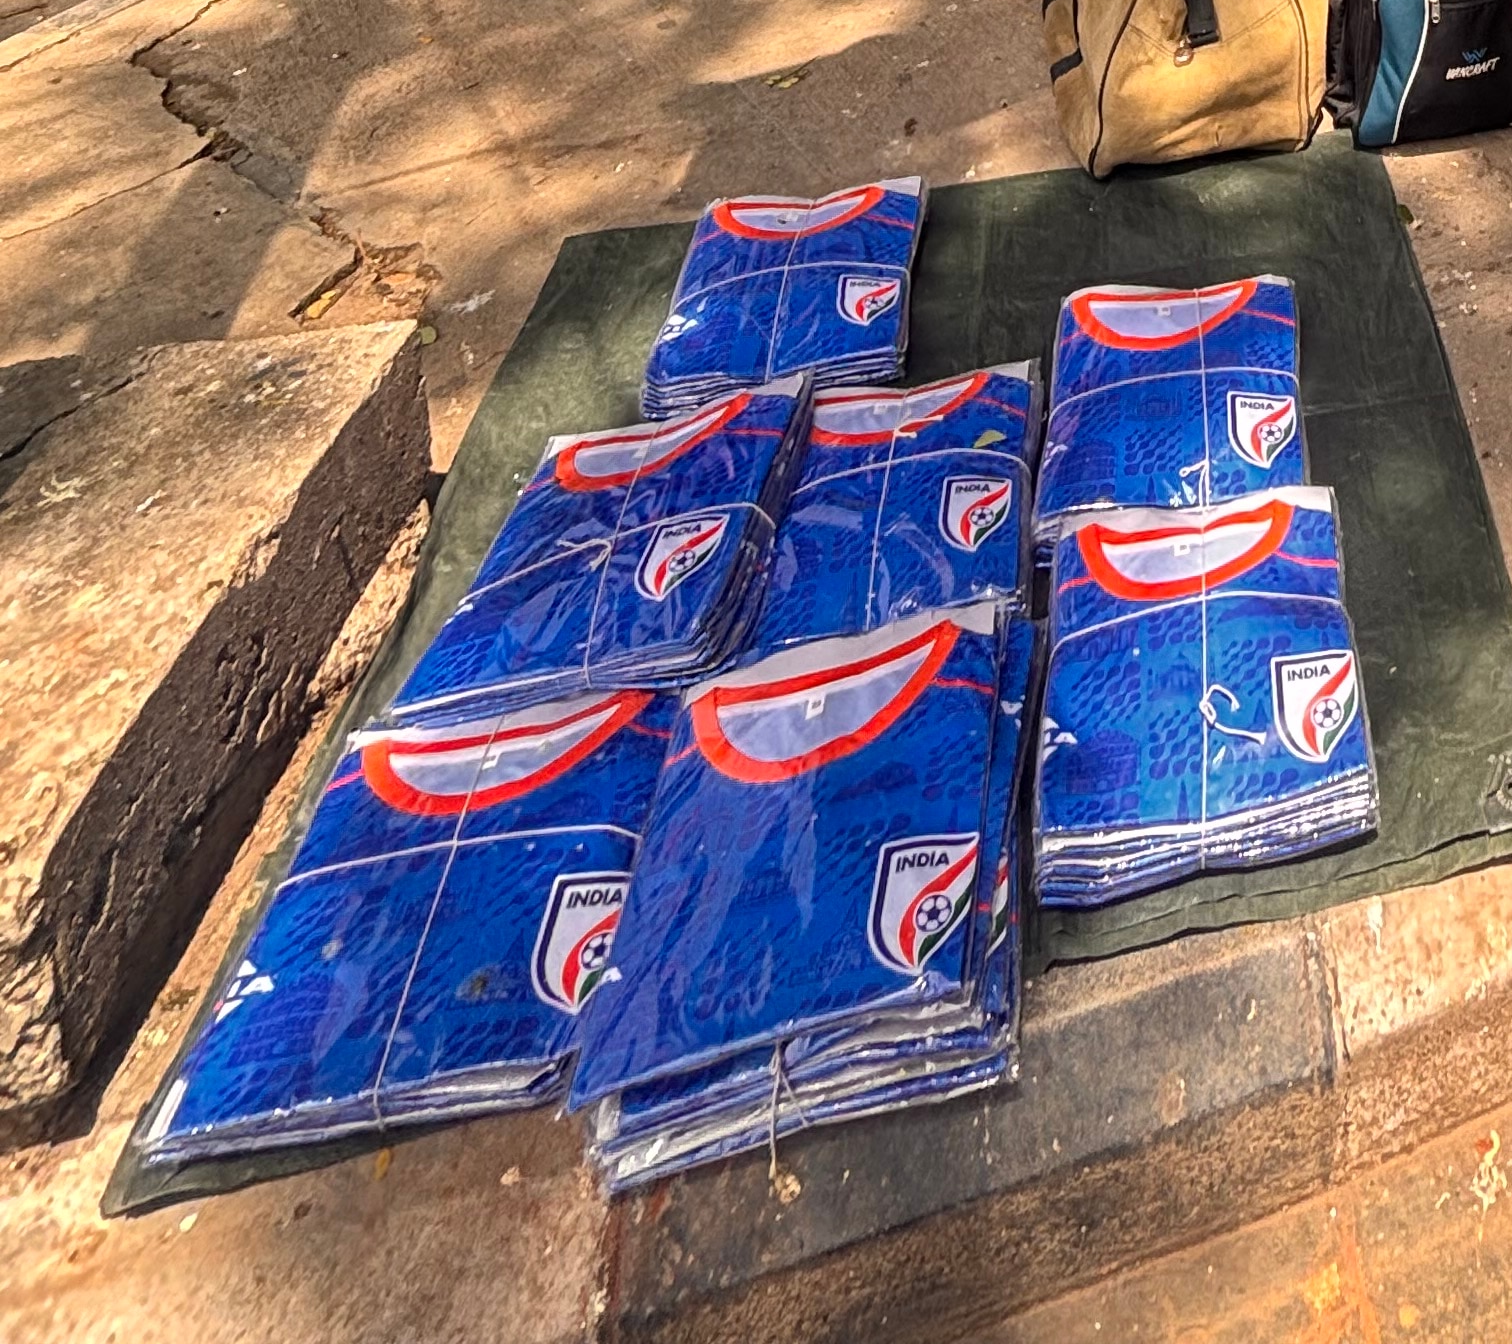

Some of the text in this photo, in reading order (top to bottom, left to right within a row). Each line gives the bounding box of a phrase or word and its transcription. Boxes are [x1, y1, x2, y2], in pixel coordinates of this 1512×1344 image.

[1240, 400, 1275, 411] INDIA
[954, 483, 991, 494] INDIA
[1286, 664, 1331, 682] INDIA
[895, 850, 950, 874] INDIA
[566, 886, 623, 909] INDIA
